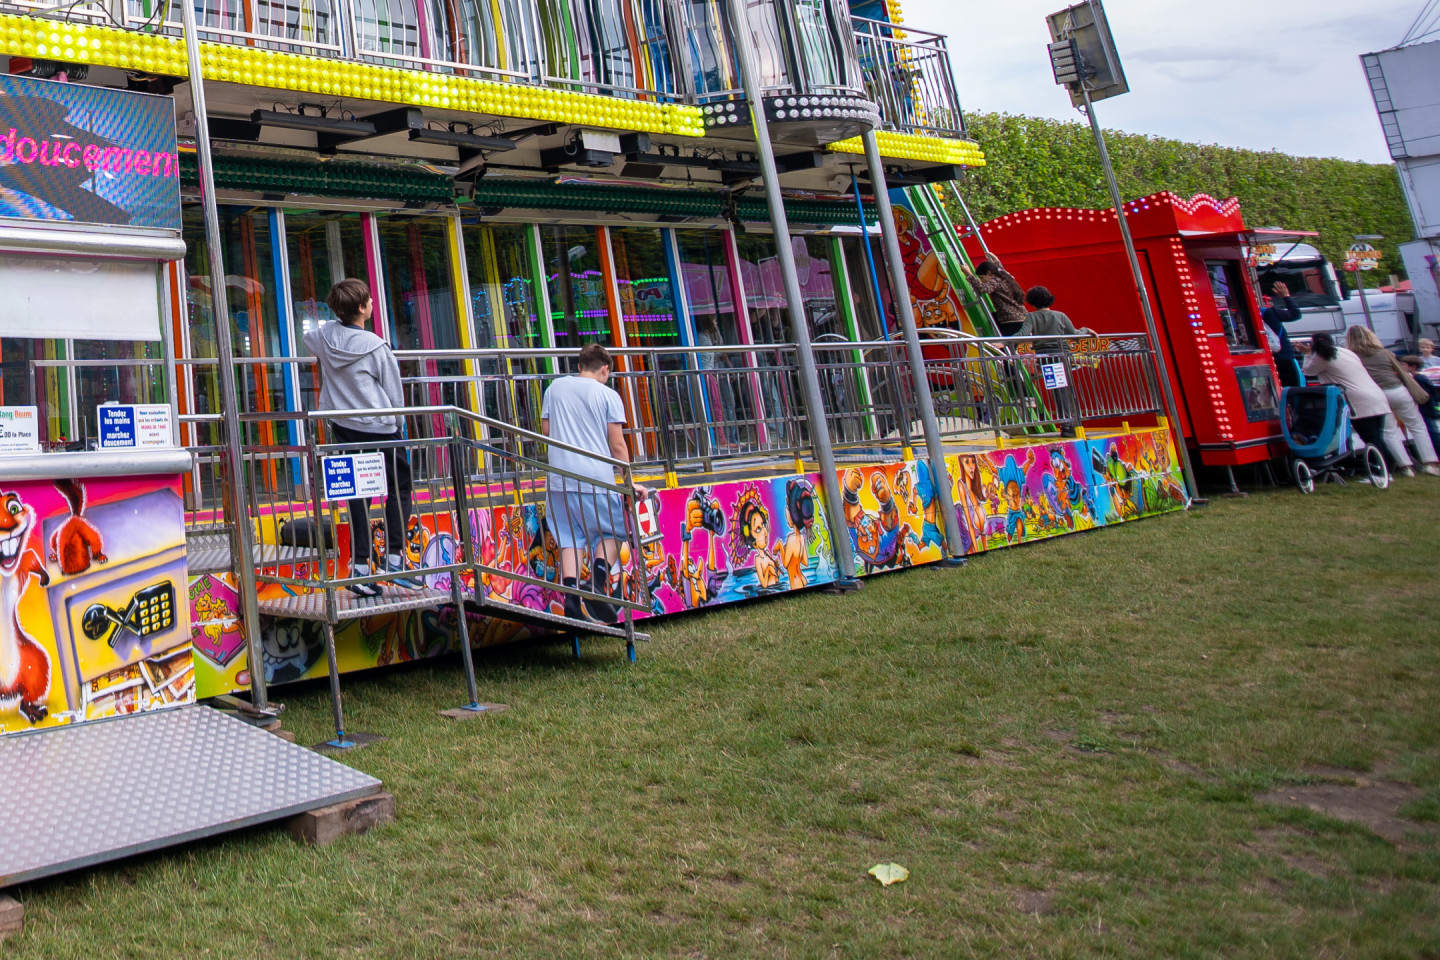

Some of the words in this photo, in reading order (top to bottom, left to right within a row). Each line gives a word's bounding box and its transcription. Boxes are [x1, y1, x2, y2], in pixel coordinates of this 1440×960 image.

[14, 410, 32, 418] Boum
[107, 409, 126, 417] Tendez
[106, 431, 130, 439] marchez
[103, 438, 133, 446] doucement
